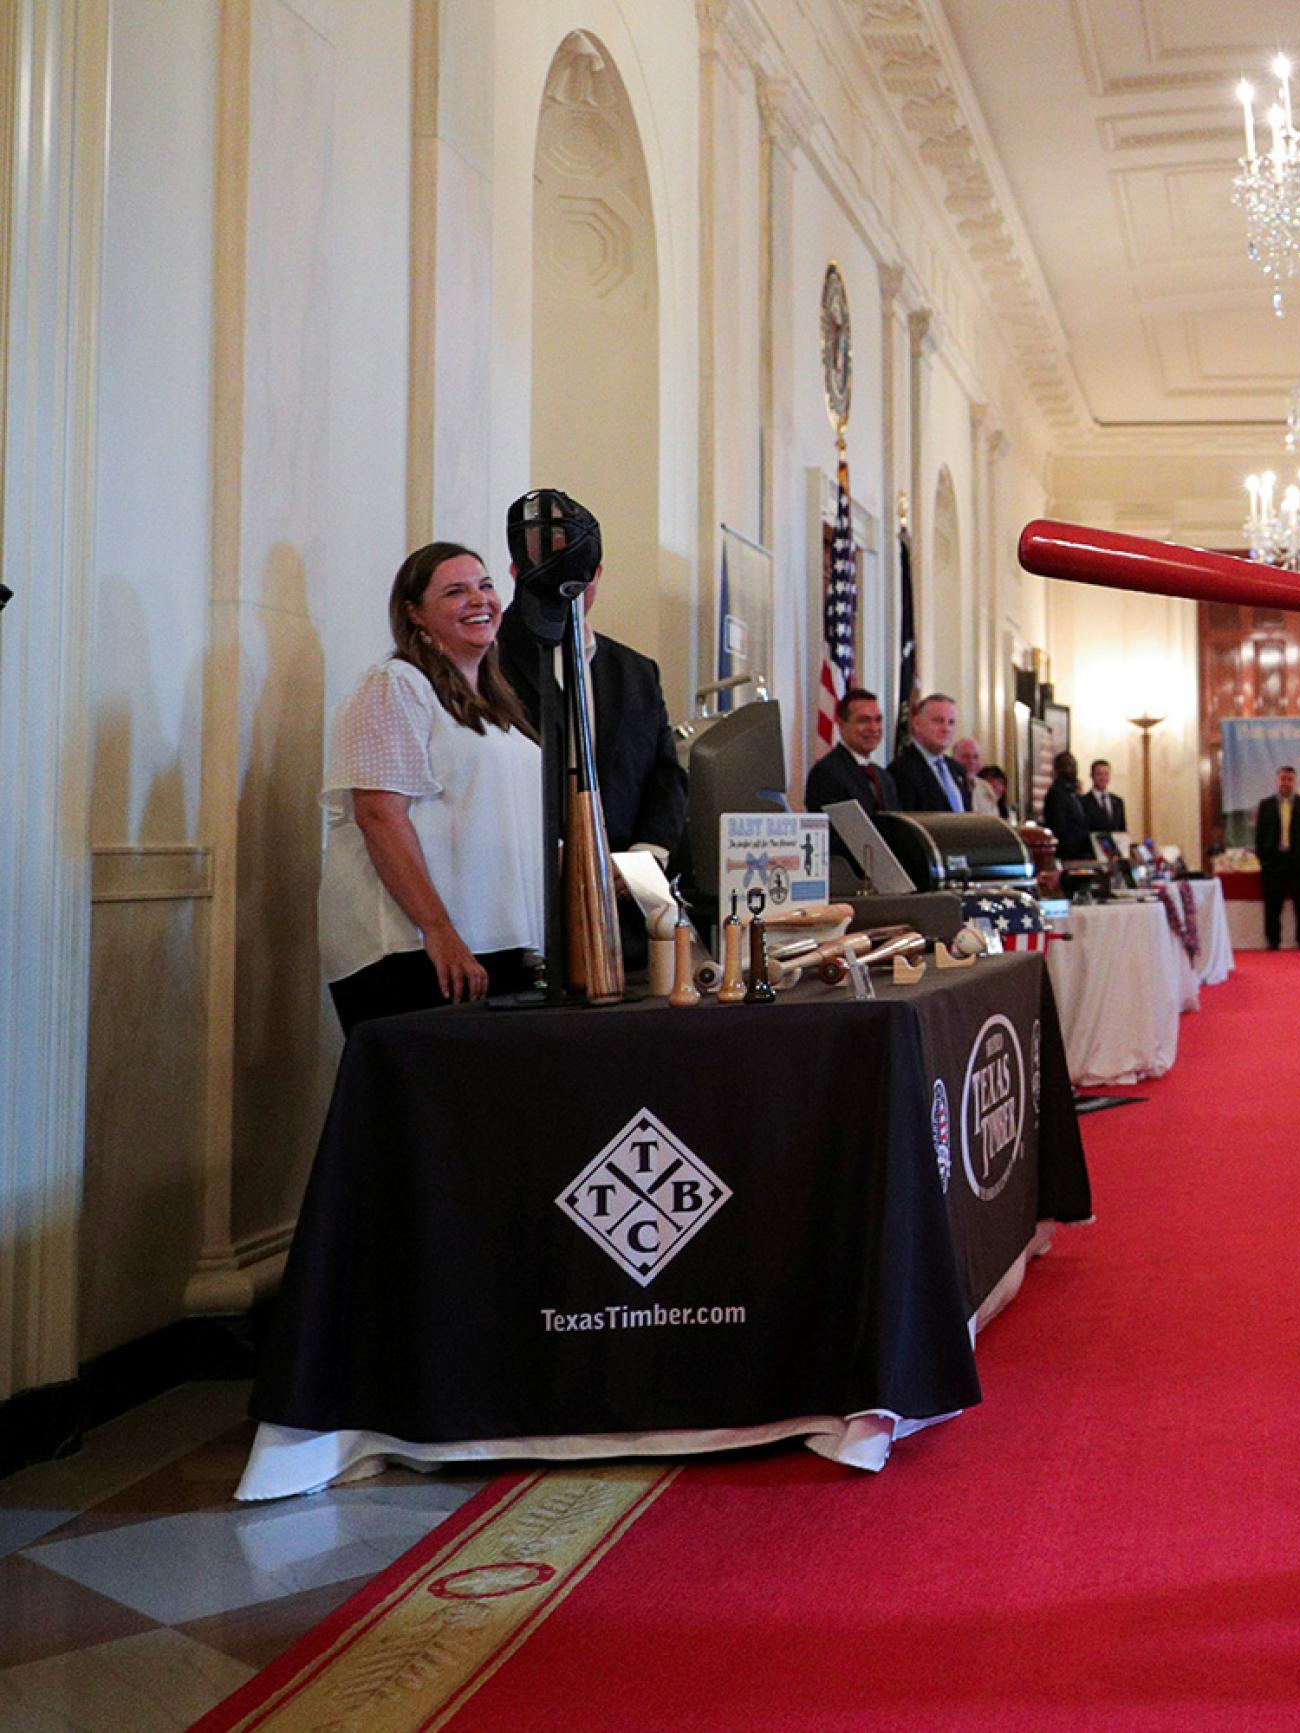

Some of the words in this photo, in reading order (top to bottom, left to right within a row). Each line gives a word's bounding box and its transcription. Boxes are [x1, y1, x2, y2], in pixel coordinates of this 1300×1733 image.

[972, 1052, 1010, 1136] TEXAS
[629, 1141, 659, 1173] T
[587, 1184, 617, 1217] T
[670, 1180, 703, 1213] B
[627, 1220, 661, 1253] C
[541, 1303, 746, 1332] TexasTimber.com
